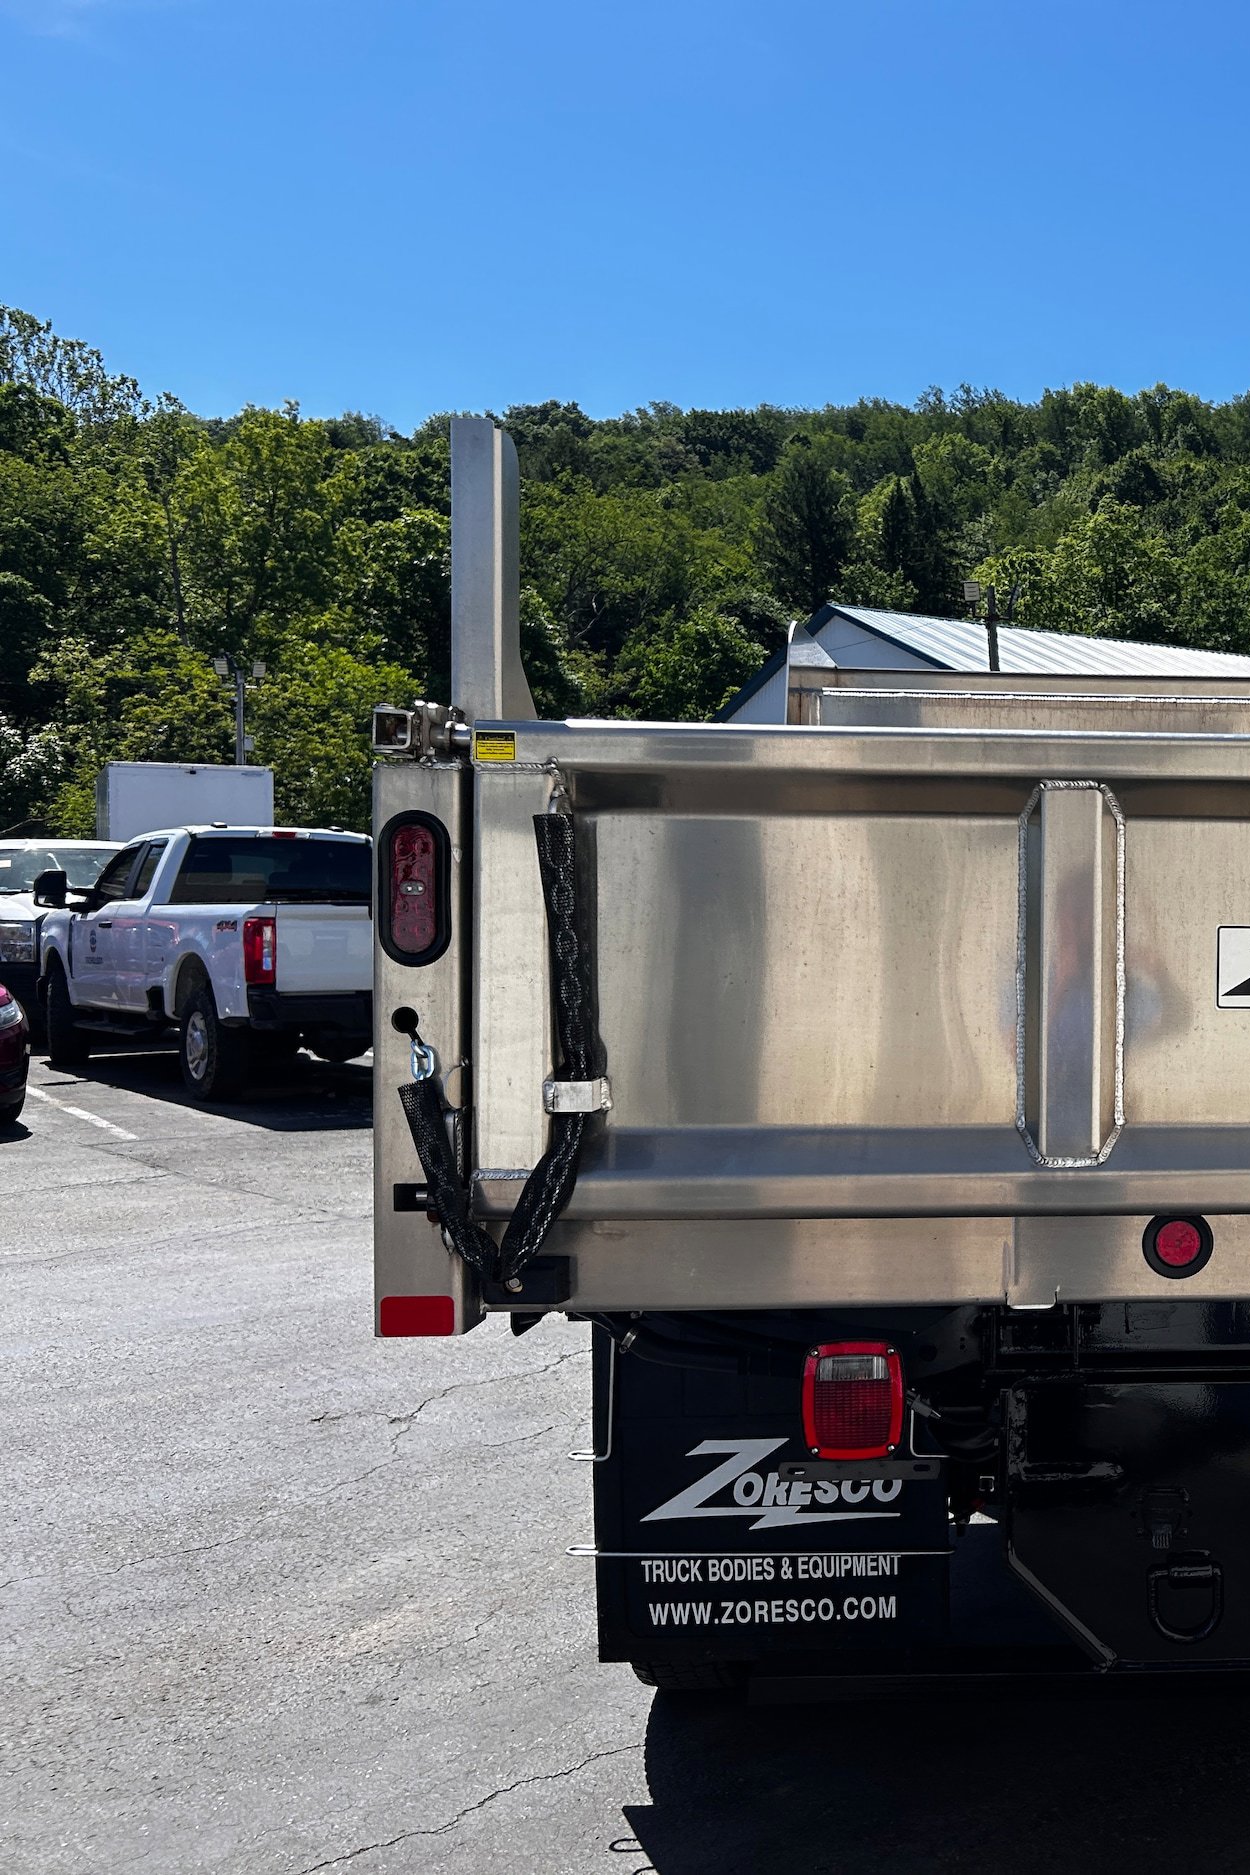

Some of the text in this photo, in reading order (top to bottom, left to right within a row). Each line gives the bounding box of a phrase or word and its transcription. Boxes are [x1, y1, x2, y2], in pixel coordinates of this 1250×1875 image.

[640, 1437, 903, 1530] ZORESCO
[641, 1554, 901, 1583] TRUCK BODIES & EQUIPMENT
[649, 1596, 897, 1626] WWW.ZORESCO.COM
